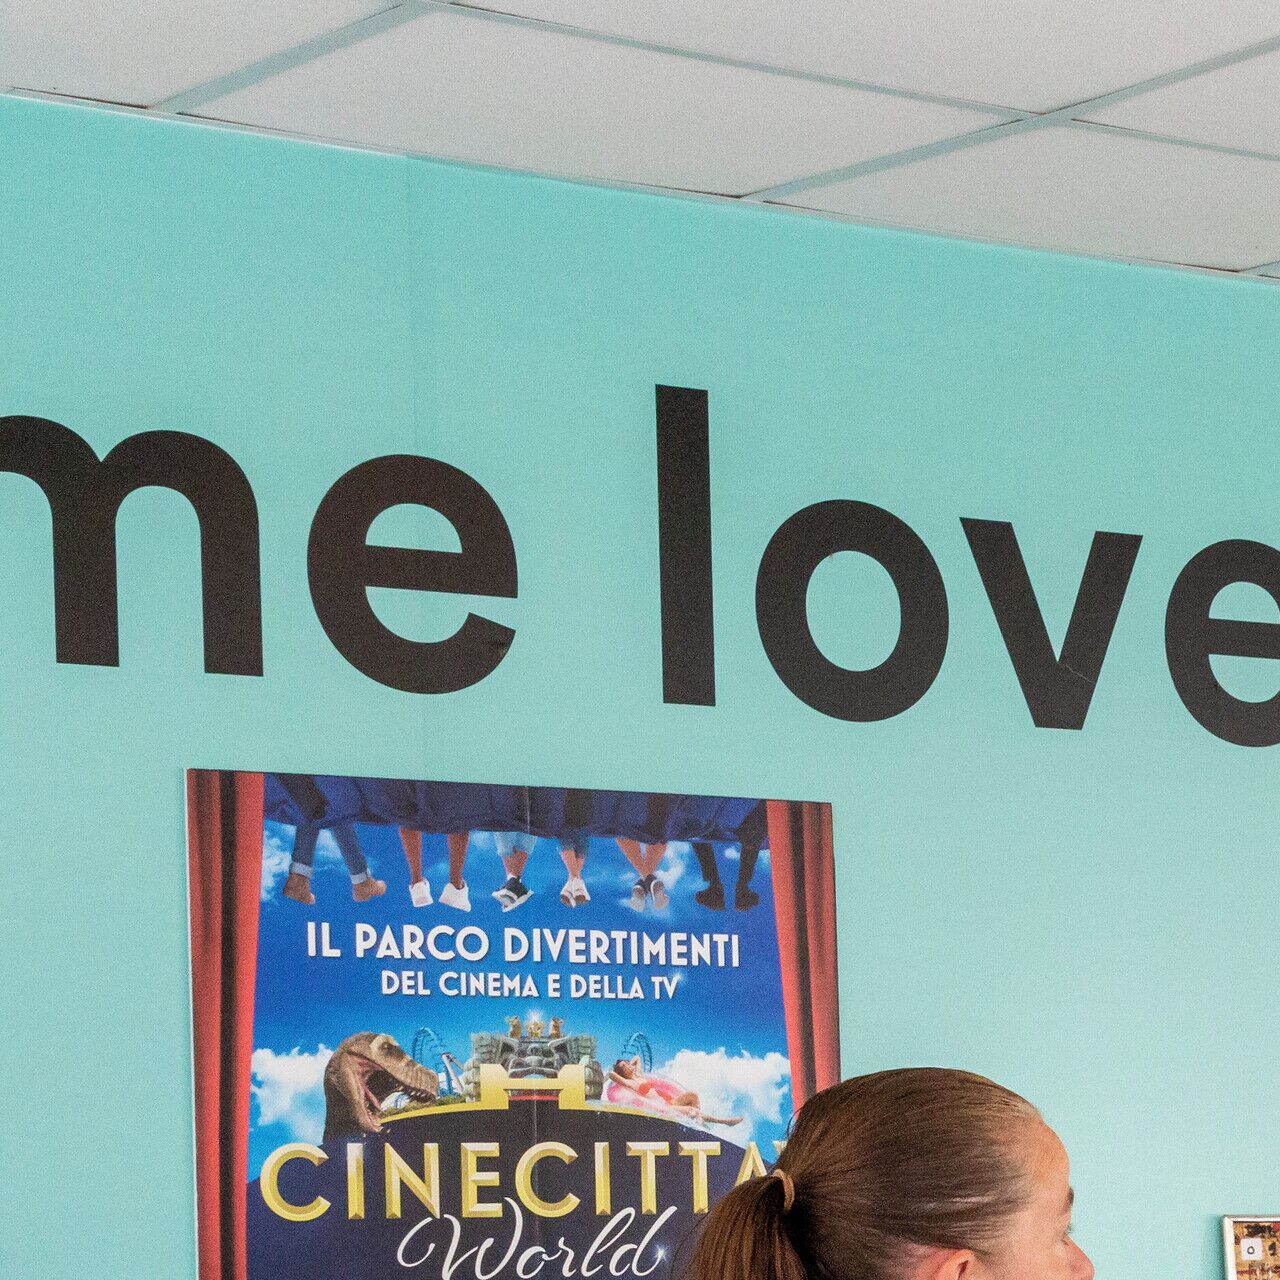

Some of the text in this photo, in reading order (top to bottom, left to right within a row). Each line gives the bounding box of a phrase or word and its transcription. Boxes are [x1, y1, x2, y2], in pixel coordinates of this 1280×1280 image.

[0, 415, 518, 694] me
[306, 921, 740, 968] IL PARCO DIVERTIMENTI
[381, 969, 679, 1001] DEL CINEMA E DELLA TV
[396, 1198, 677, 1280] World
